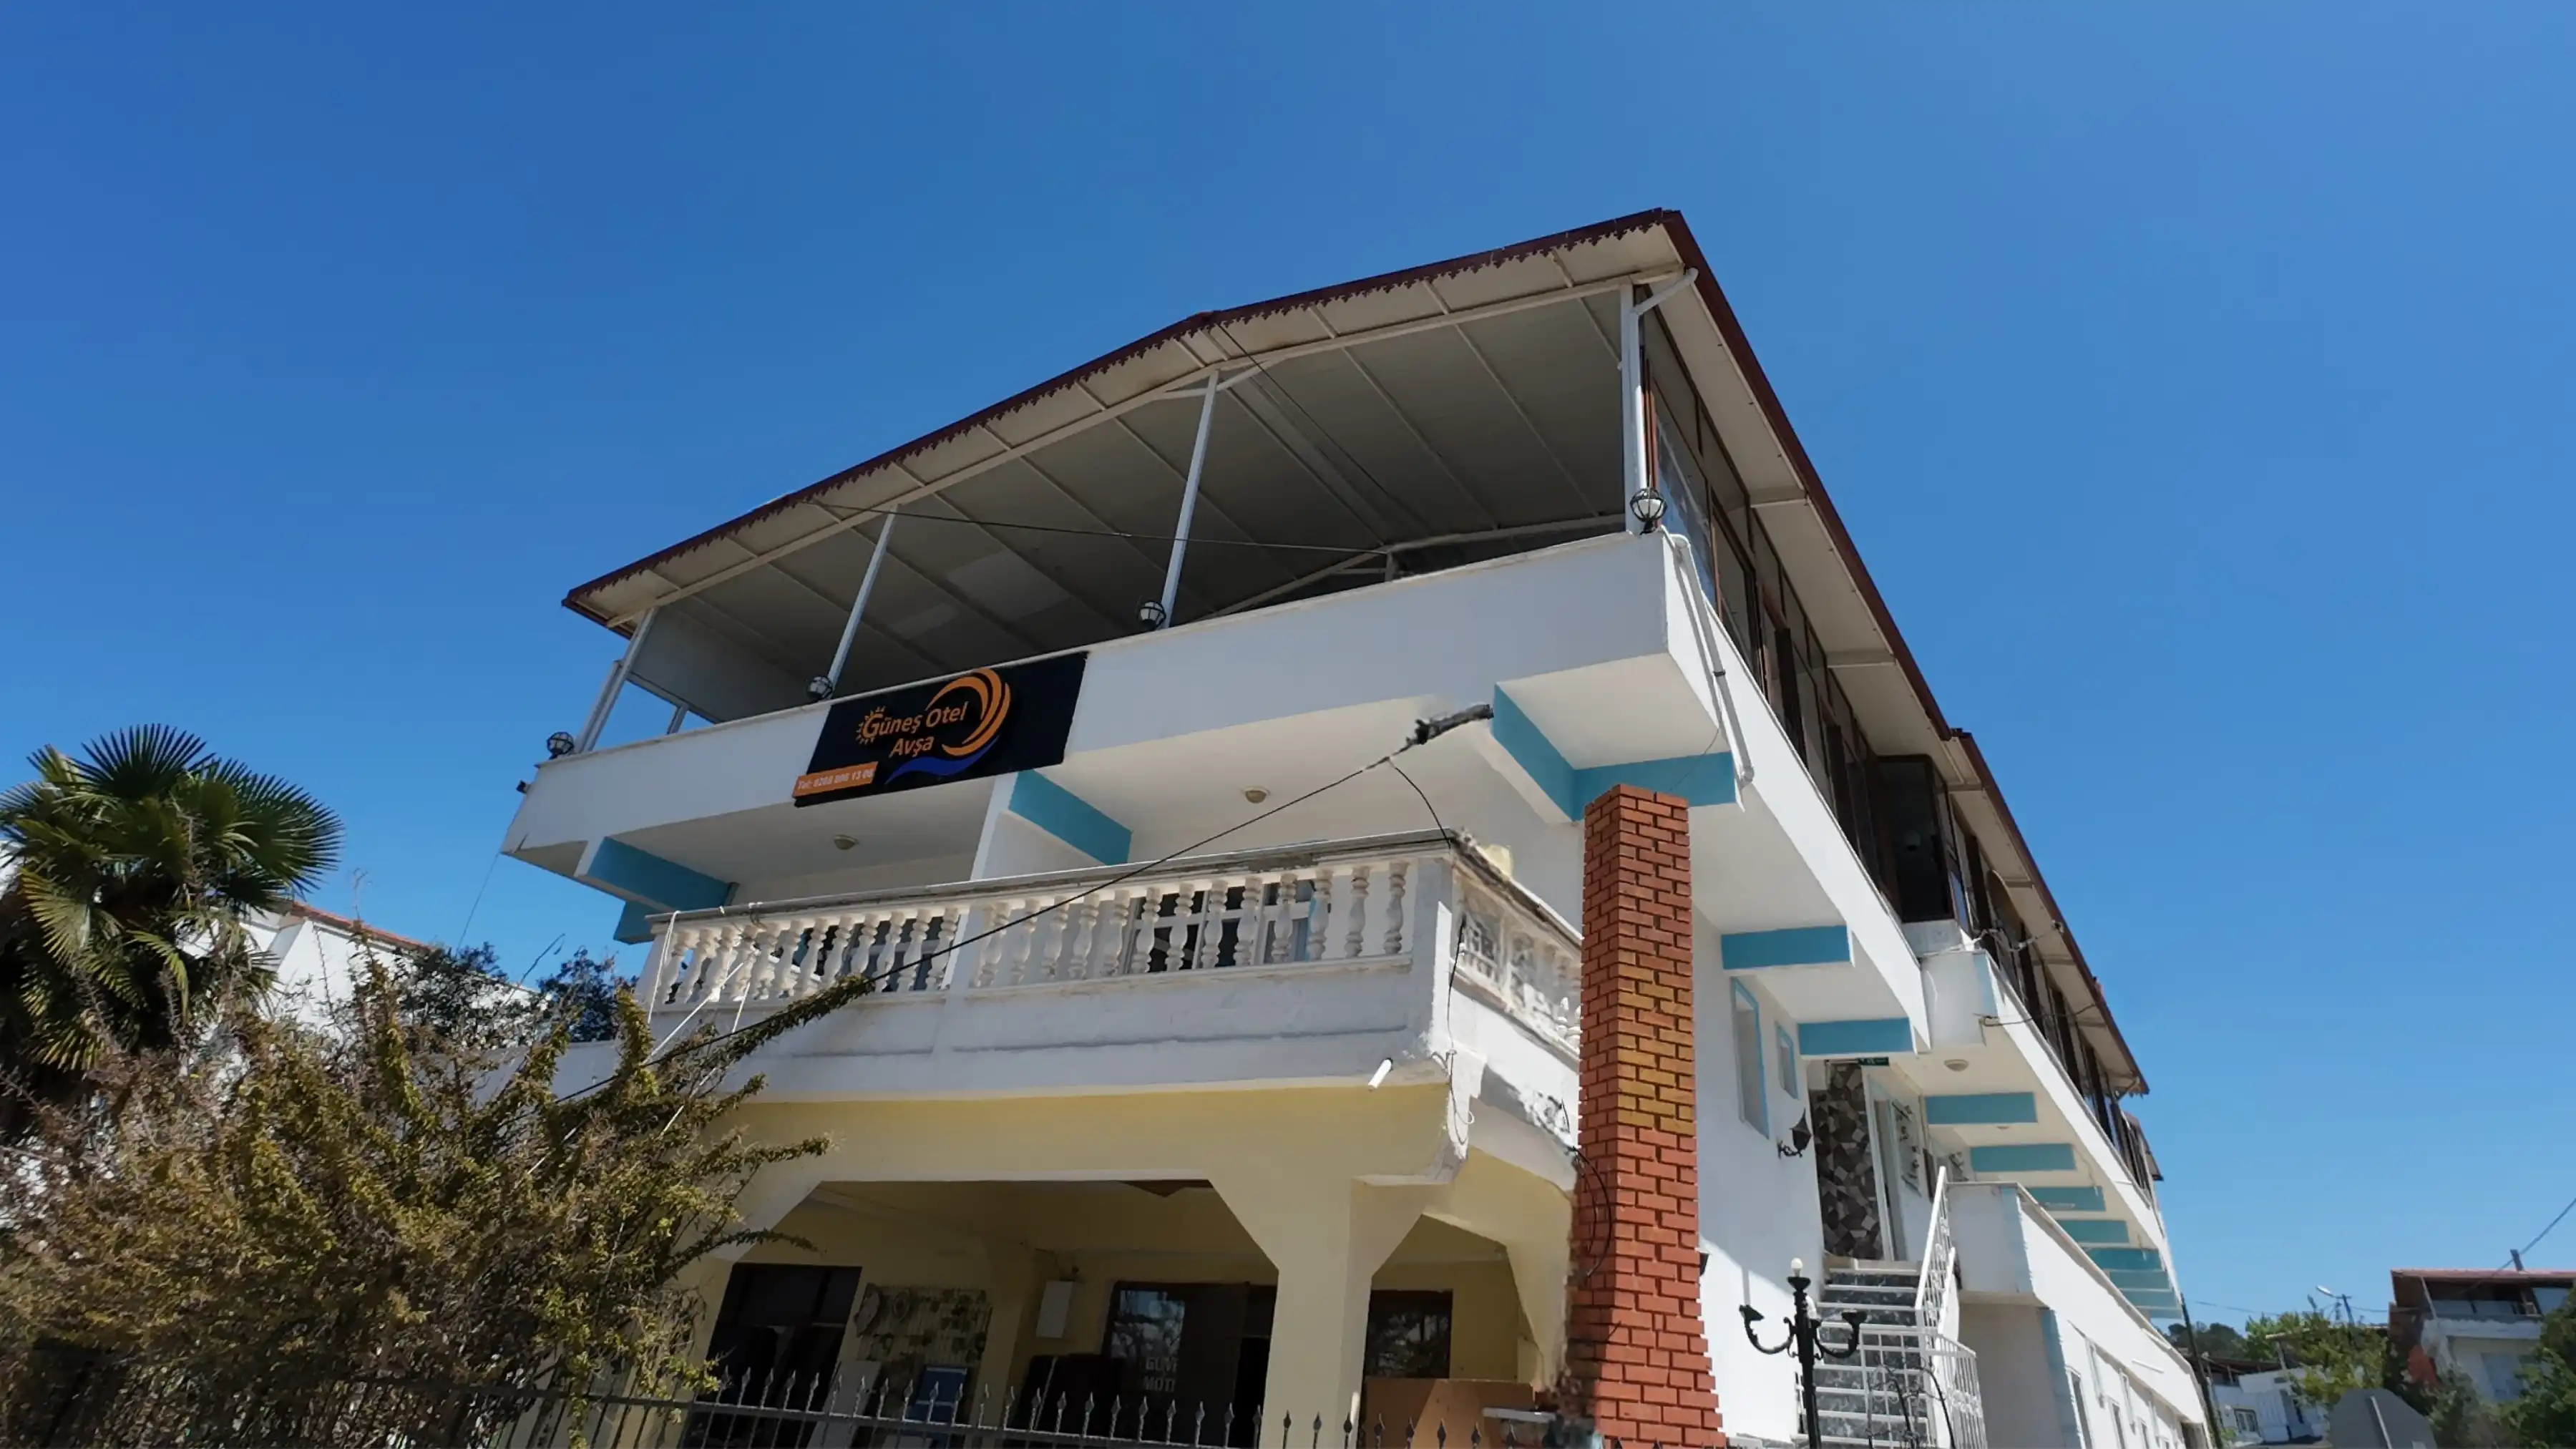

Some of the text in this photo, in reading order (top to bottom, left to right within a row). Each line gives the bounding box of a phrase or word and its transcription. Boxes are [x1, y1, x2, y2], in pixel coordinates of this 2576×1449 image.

[862, 701, 968, 738] Güneş Otel
[888, 736, 935, 758] Avşa
